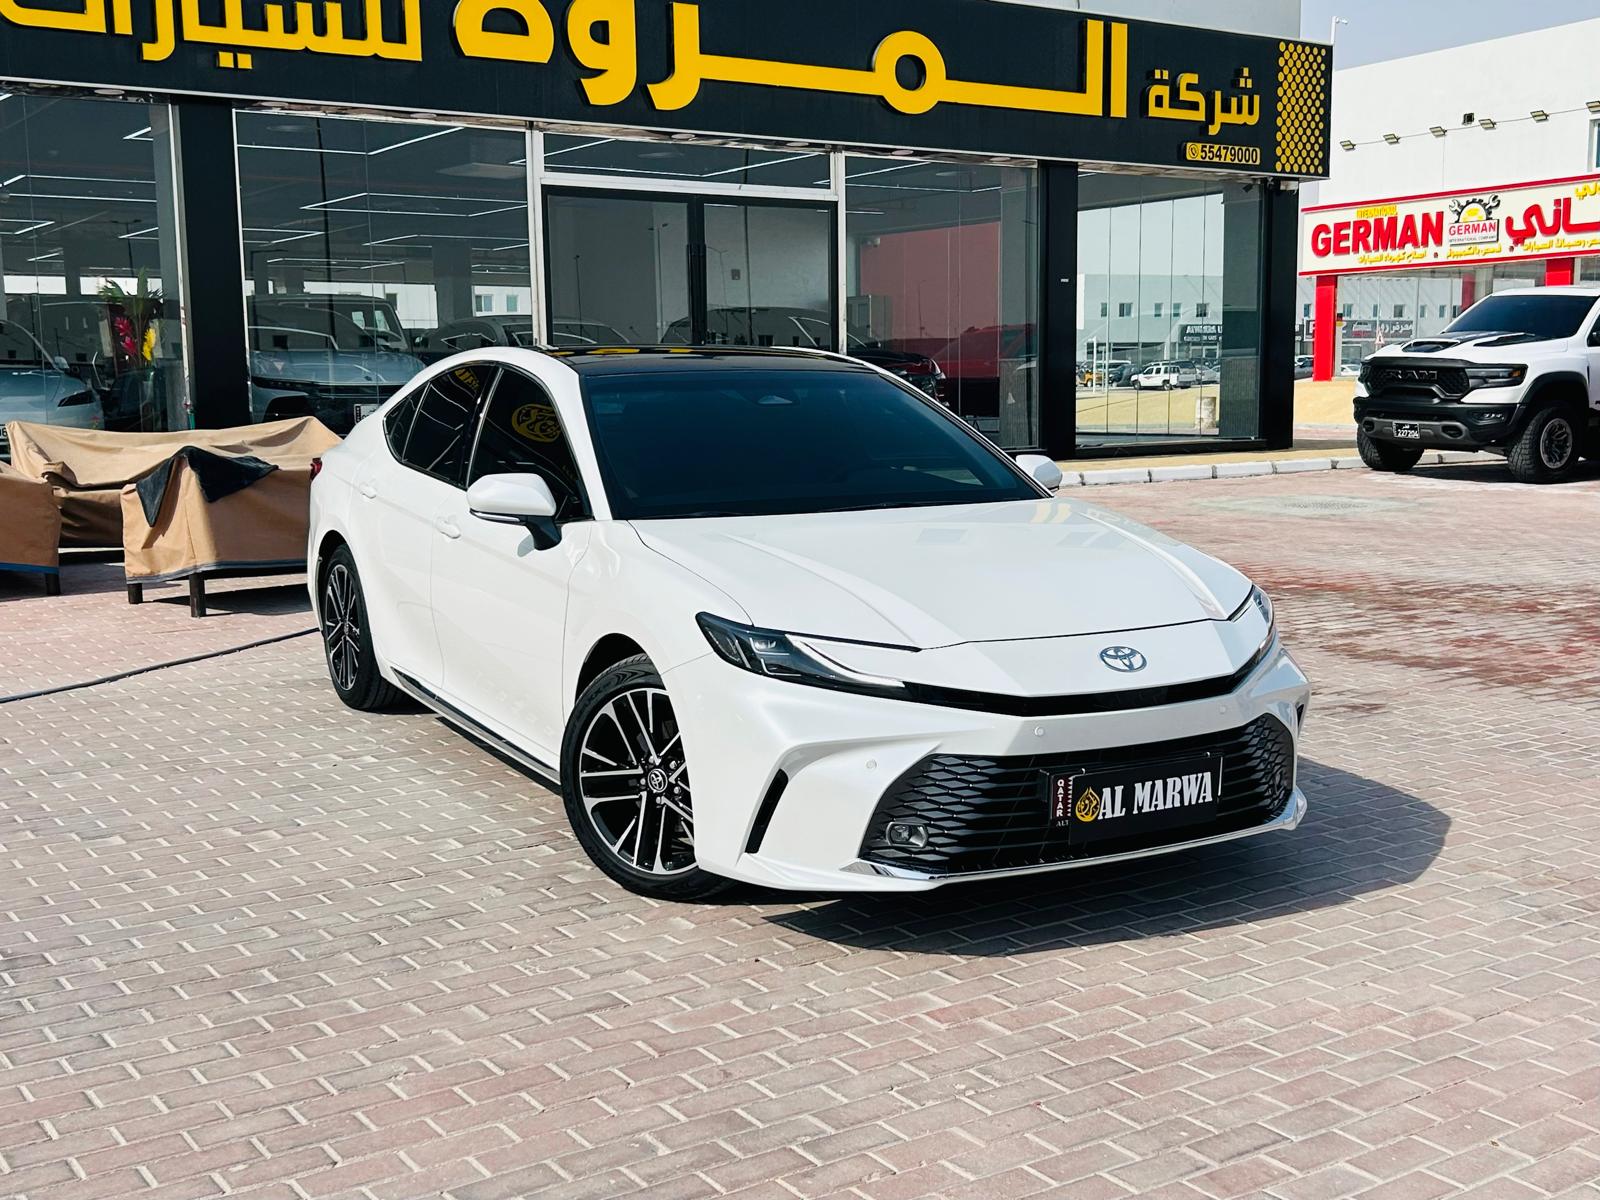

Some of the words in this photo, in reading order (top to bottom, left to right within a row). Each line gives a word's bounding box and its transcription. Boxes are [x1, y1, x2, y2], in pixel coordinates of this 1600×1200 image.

[1148, 66, 1260, 136] شركة
[1200, 144, 1259, 164] 55479000
[1311, 211, 1445, 258] GERMAN
[1448, 222, 1497, 236] GERMAN
[1386, 369, 1438, 381] RAM
[1056, 779, 1065, 817] QATAR
[1097, 785, 1126, 820] AL
[1132, 771, 1213, 815] MARWA
